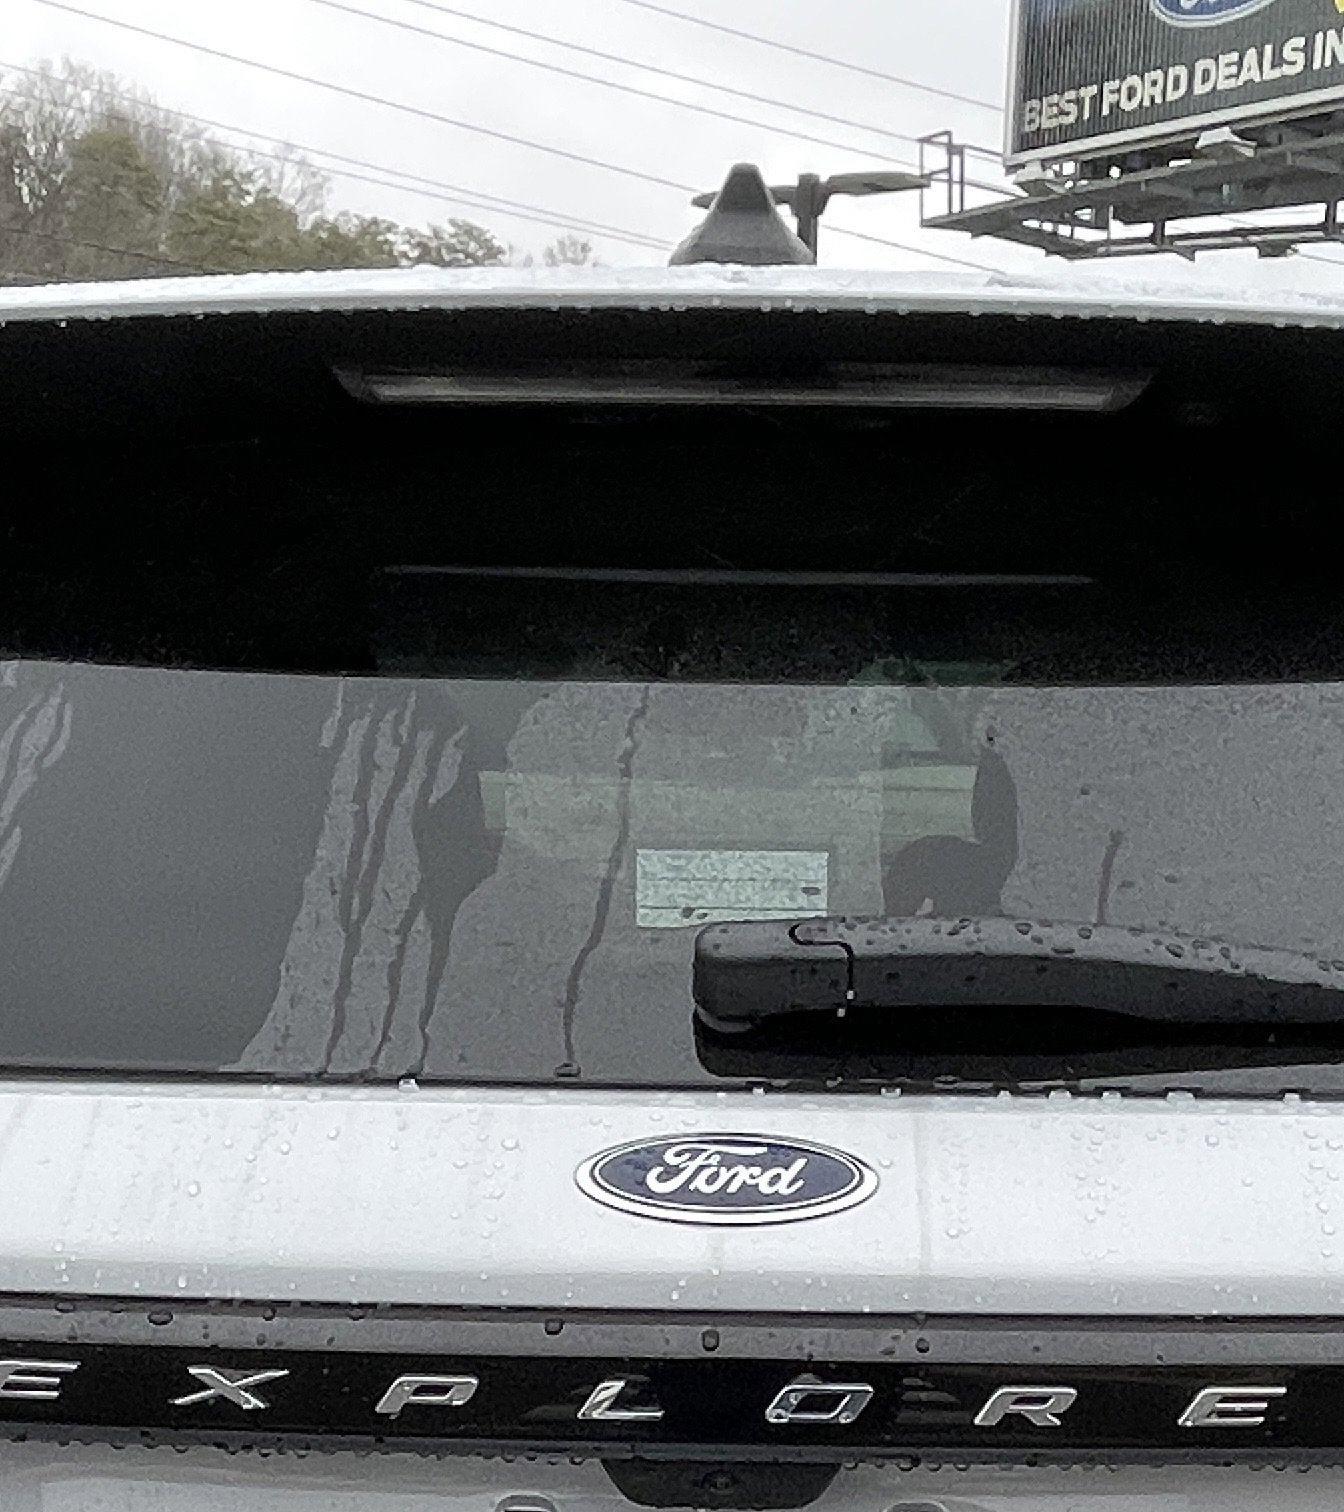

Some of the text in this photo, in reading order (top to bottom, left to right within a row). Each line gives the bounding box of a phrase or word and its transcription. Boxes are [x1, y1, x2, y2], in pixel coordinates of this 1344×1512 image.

[1024, 85, 1098, 133] BEST
[1101, 64, 1188, 117] FORD
[1192, 37, 1306, 96] DEALS
[646, 1144, 807, 1196] Ford
